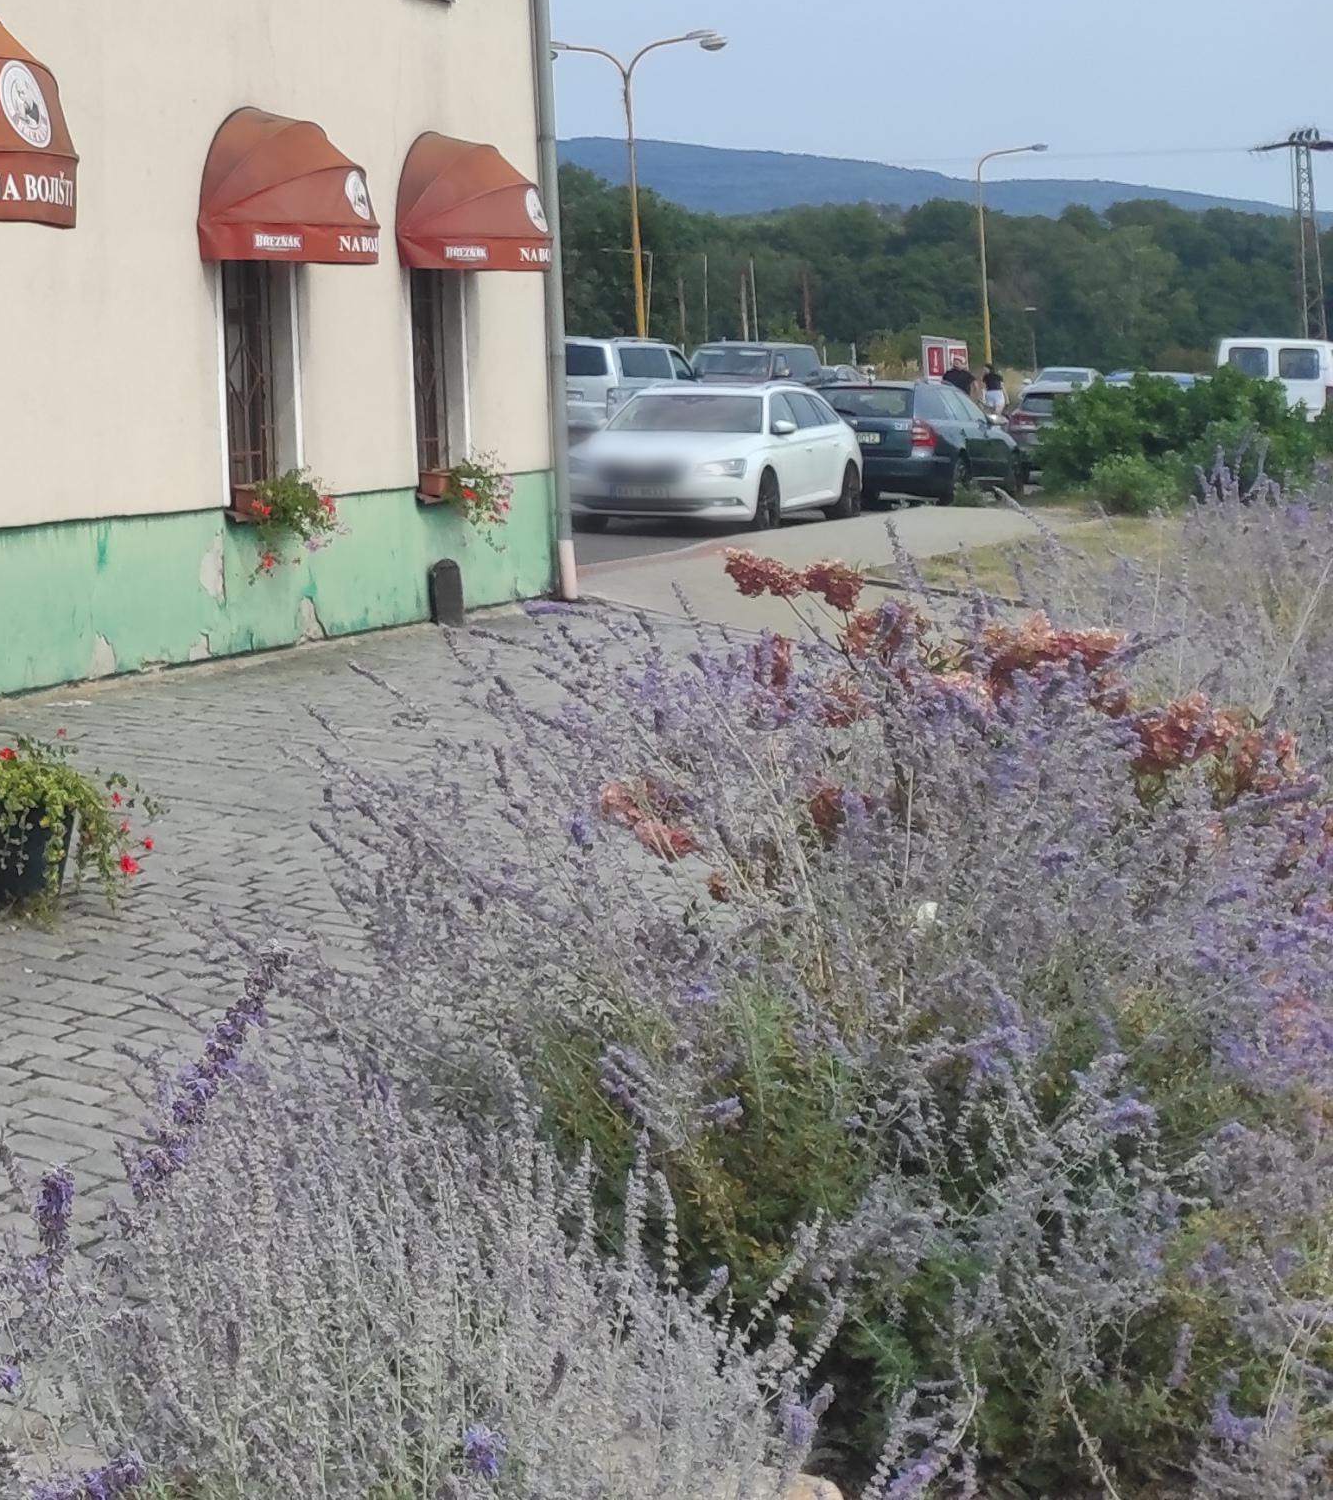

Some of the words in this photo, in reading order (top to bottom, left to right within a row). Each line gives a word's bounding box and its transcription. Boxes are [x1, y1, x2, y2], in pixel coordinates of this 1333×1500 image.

[23, 171, 73, 207] BOJIŠTI
[338, 235, 361, 252] NA
[518, 247, 538, 262] NA
